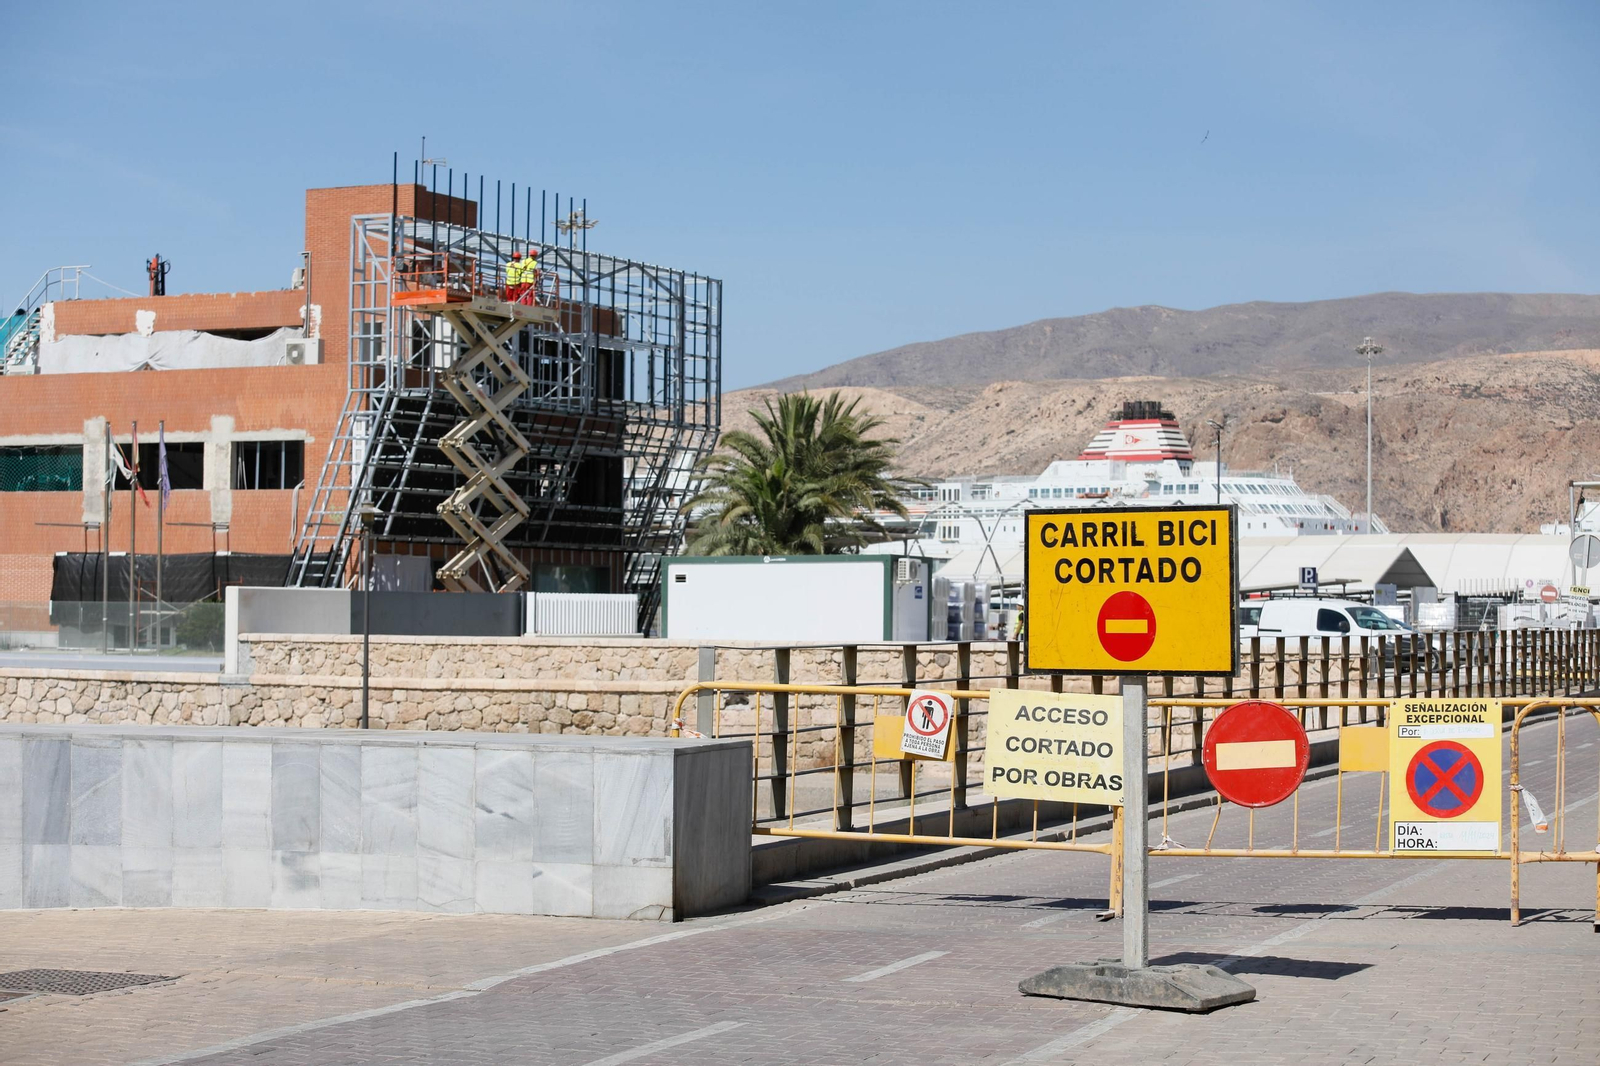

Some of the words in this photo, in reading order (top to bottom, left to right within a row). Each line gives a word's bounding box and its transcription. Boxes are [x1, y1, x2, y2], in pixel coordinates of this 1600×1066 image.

[1040, 521, 1145, 548] CARRIL
[1158, 519, 1217, 546] BICI
[1054, 556, 1202, 584] CORTADO
[1404, 702, 1488, 713] SEÑALIZACIÓN
[1014, 705, 1109, 726] ACCESO
[1406, 714, 1485, 724] EXCEPCIONAL
[904, 733, 926, 741] PROHIBIDO
[1401, 727, 1420, 736] Por:
[1005, 736, 1114, 759] CORTADO
[992, 766, 1038, 786] POR
[1044, 769, 1123, 792] OBRAS
[1397, 823, 1423, 836] DÍA:
[1397, 838, 1438, 849] HORA:
